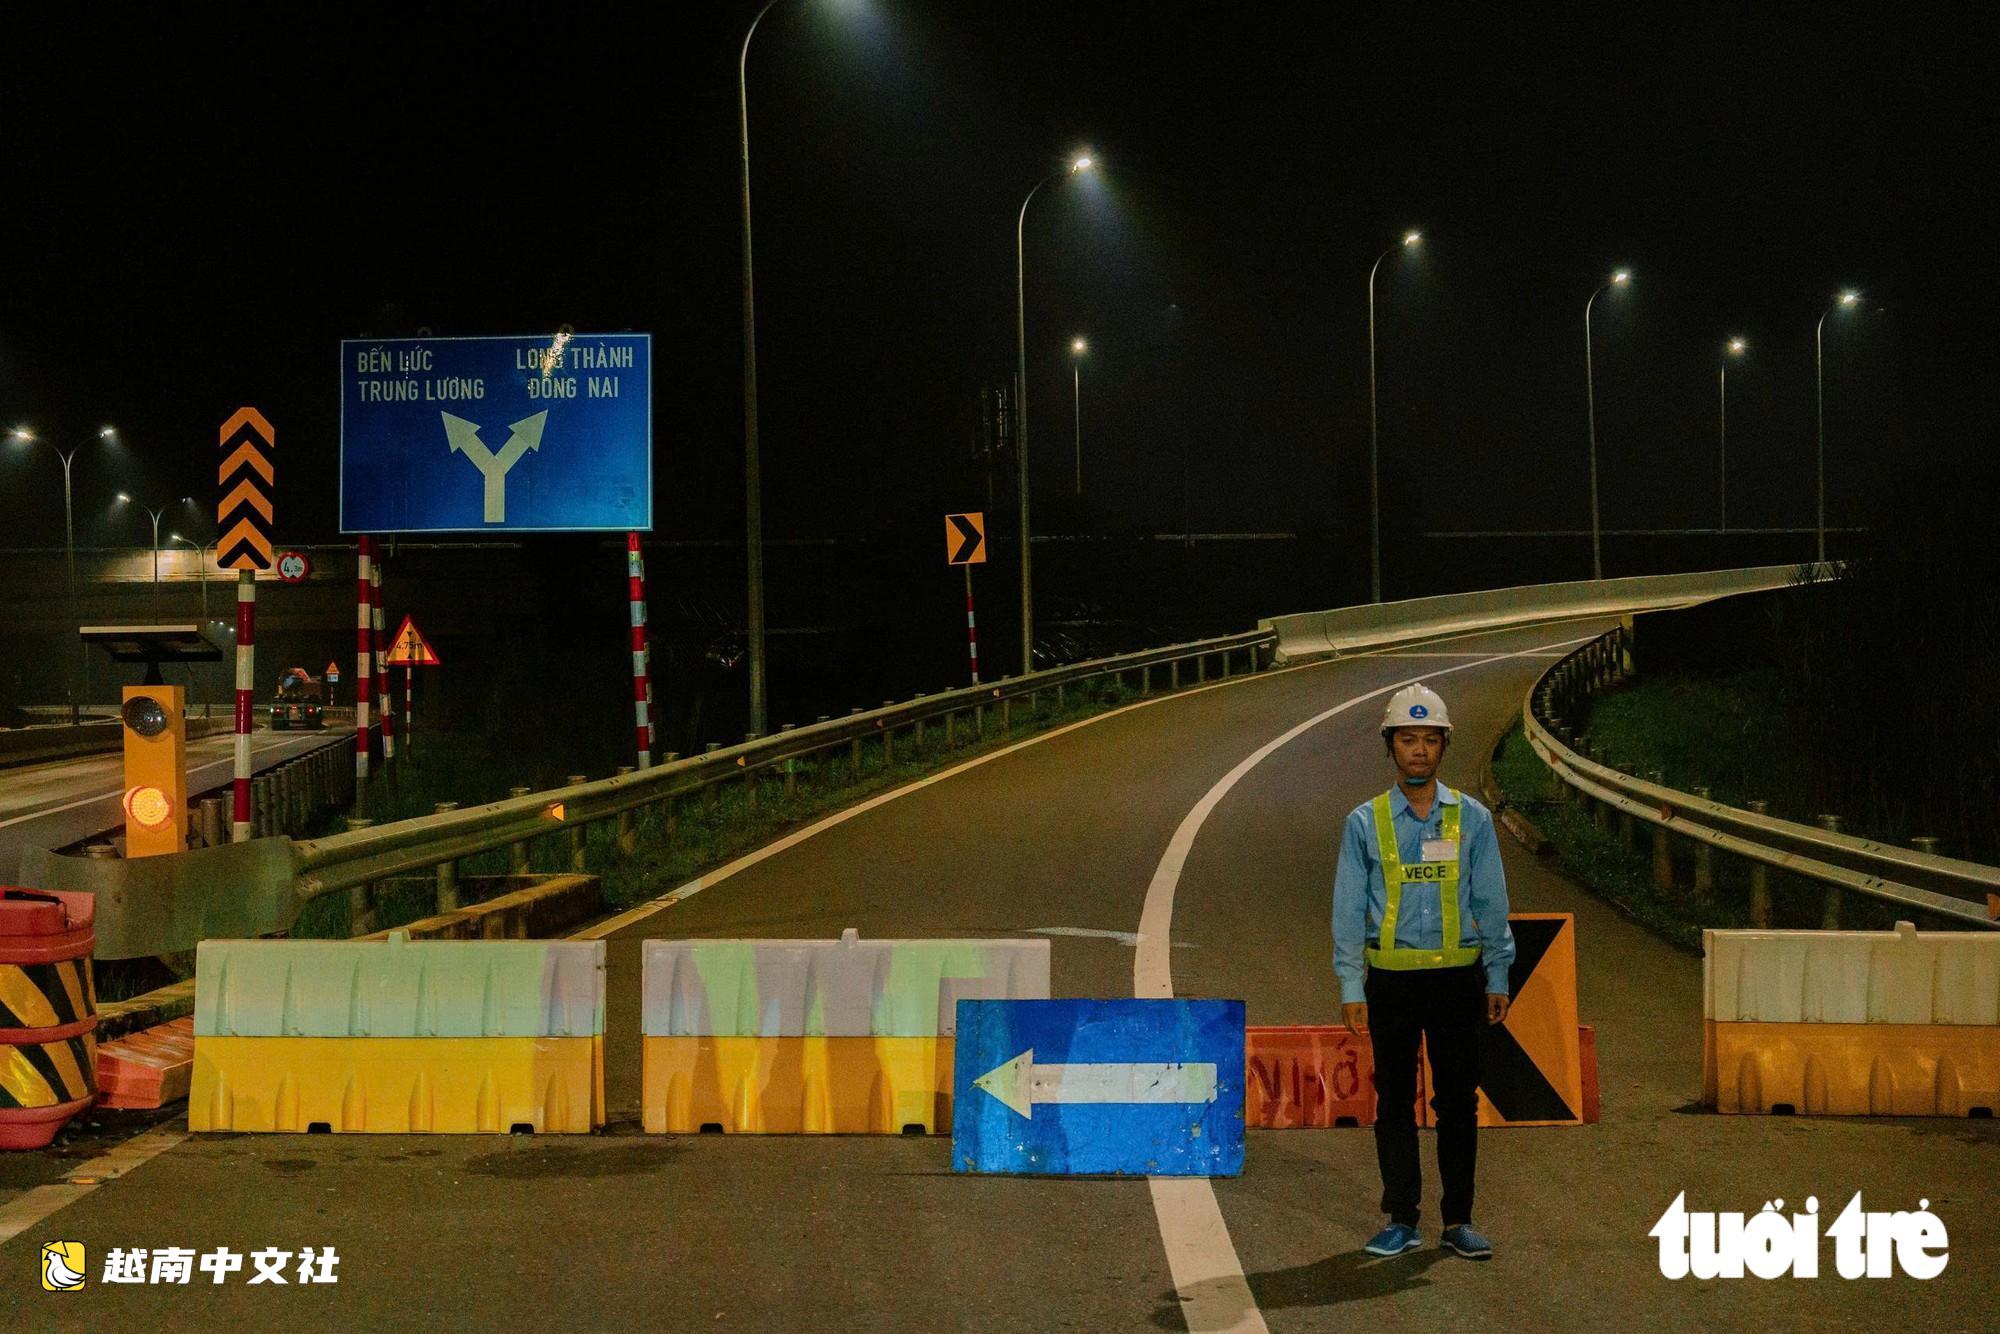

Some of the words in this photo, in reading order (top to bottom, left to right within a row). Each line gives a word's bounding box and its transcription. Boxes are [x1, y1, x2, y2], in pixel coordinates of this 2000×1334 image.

[358, 345, 392, 372] BẾN
[400, 345, 433, 372] LỨC
[571, 342, 633, 369] THÀNH
[358, 380, 419, 402] TRUNG
[588, 377, 619, 398] NAI
